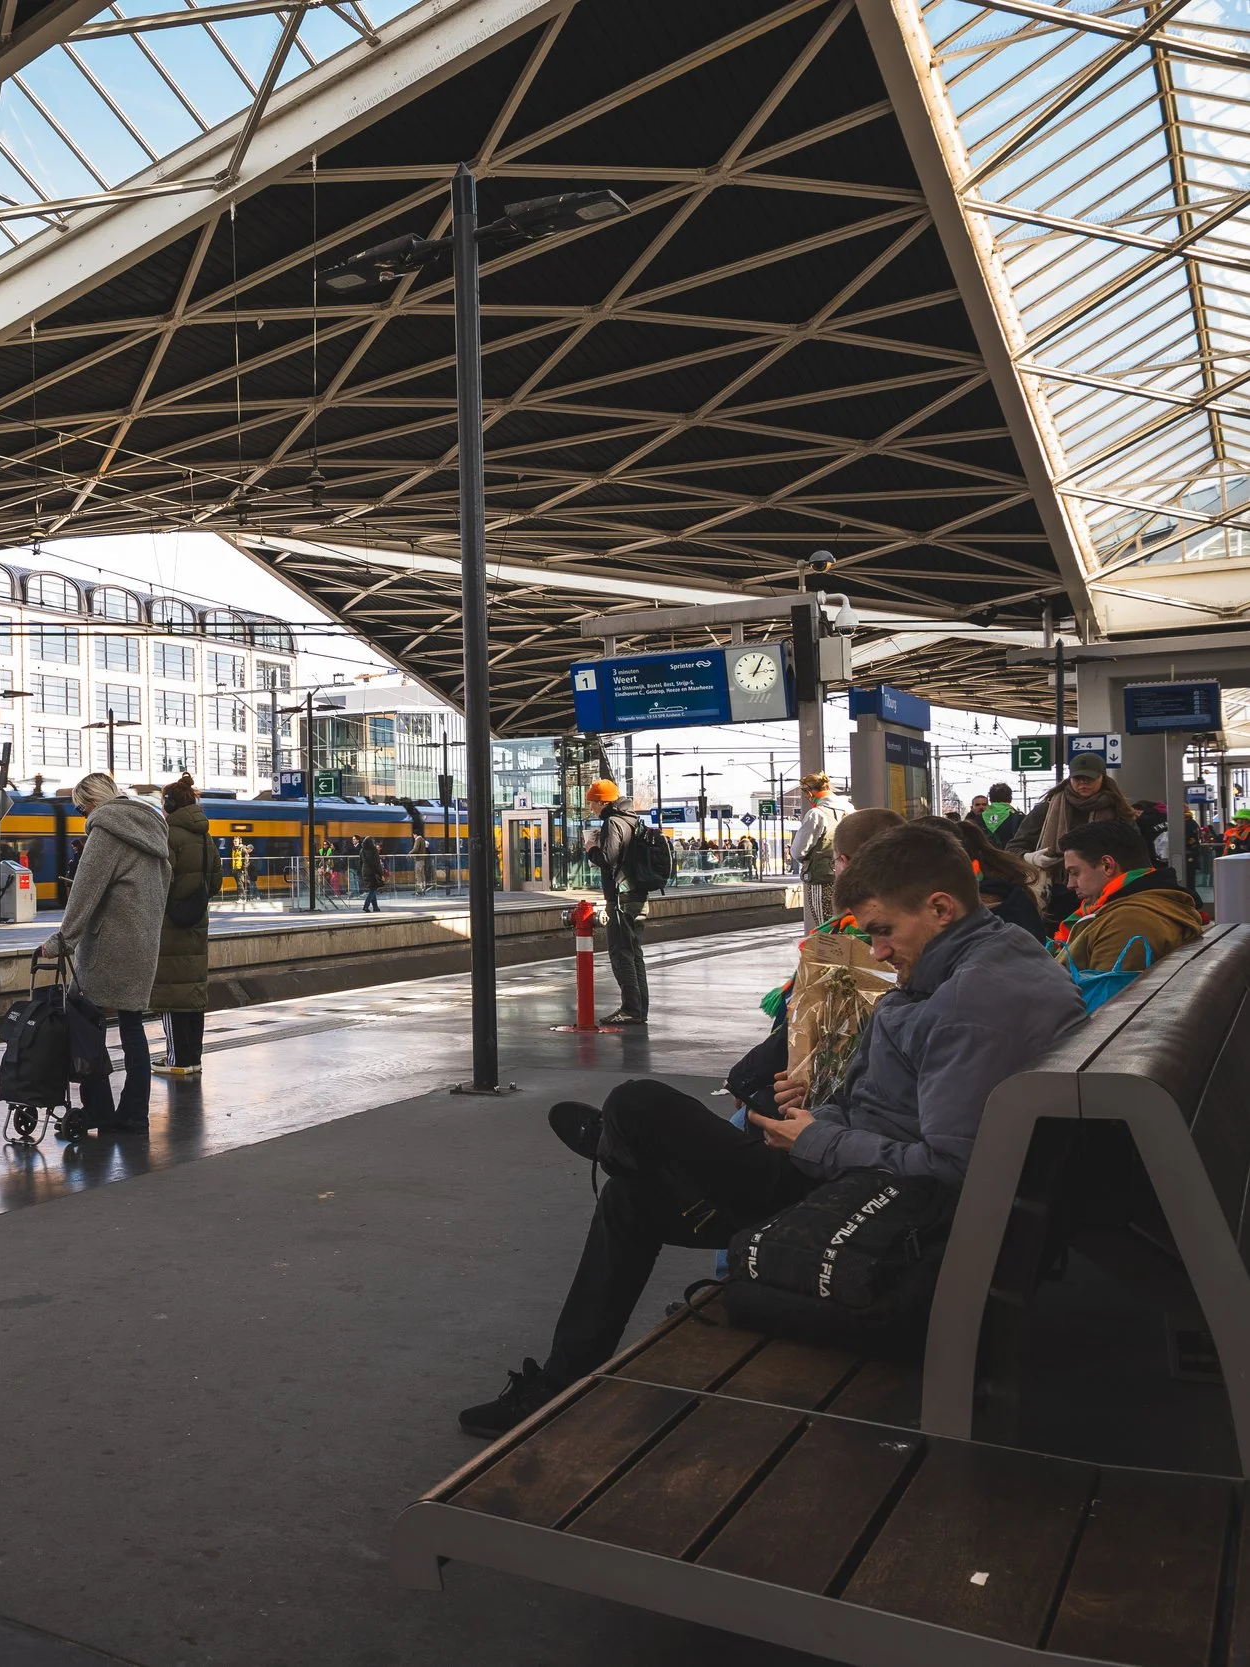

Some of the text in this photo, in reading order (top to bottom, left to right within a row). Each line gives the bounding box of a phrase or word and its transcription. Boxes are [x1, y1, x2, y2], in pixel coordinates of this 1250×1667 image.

[669, 662, 695, 671] Sprinter
[582, 677, 589, 689] 1
[612, 676, 638, 684] Weert
[861, 1193, 890, 1214] FILA
[830, 1221, 858, 1245] FILA
[748, 1246, 759, 1279] FILA
[819, 1263, 832, 1298] FILA
